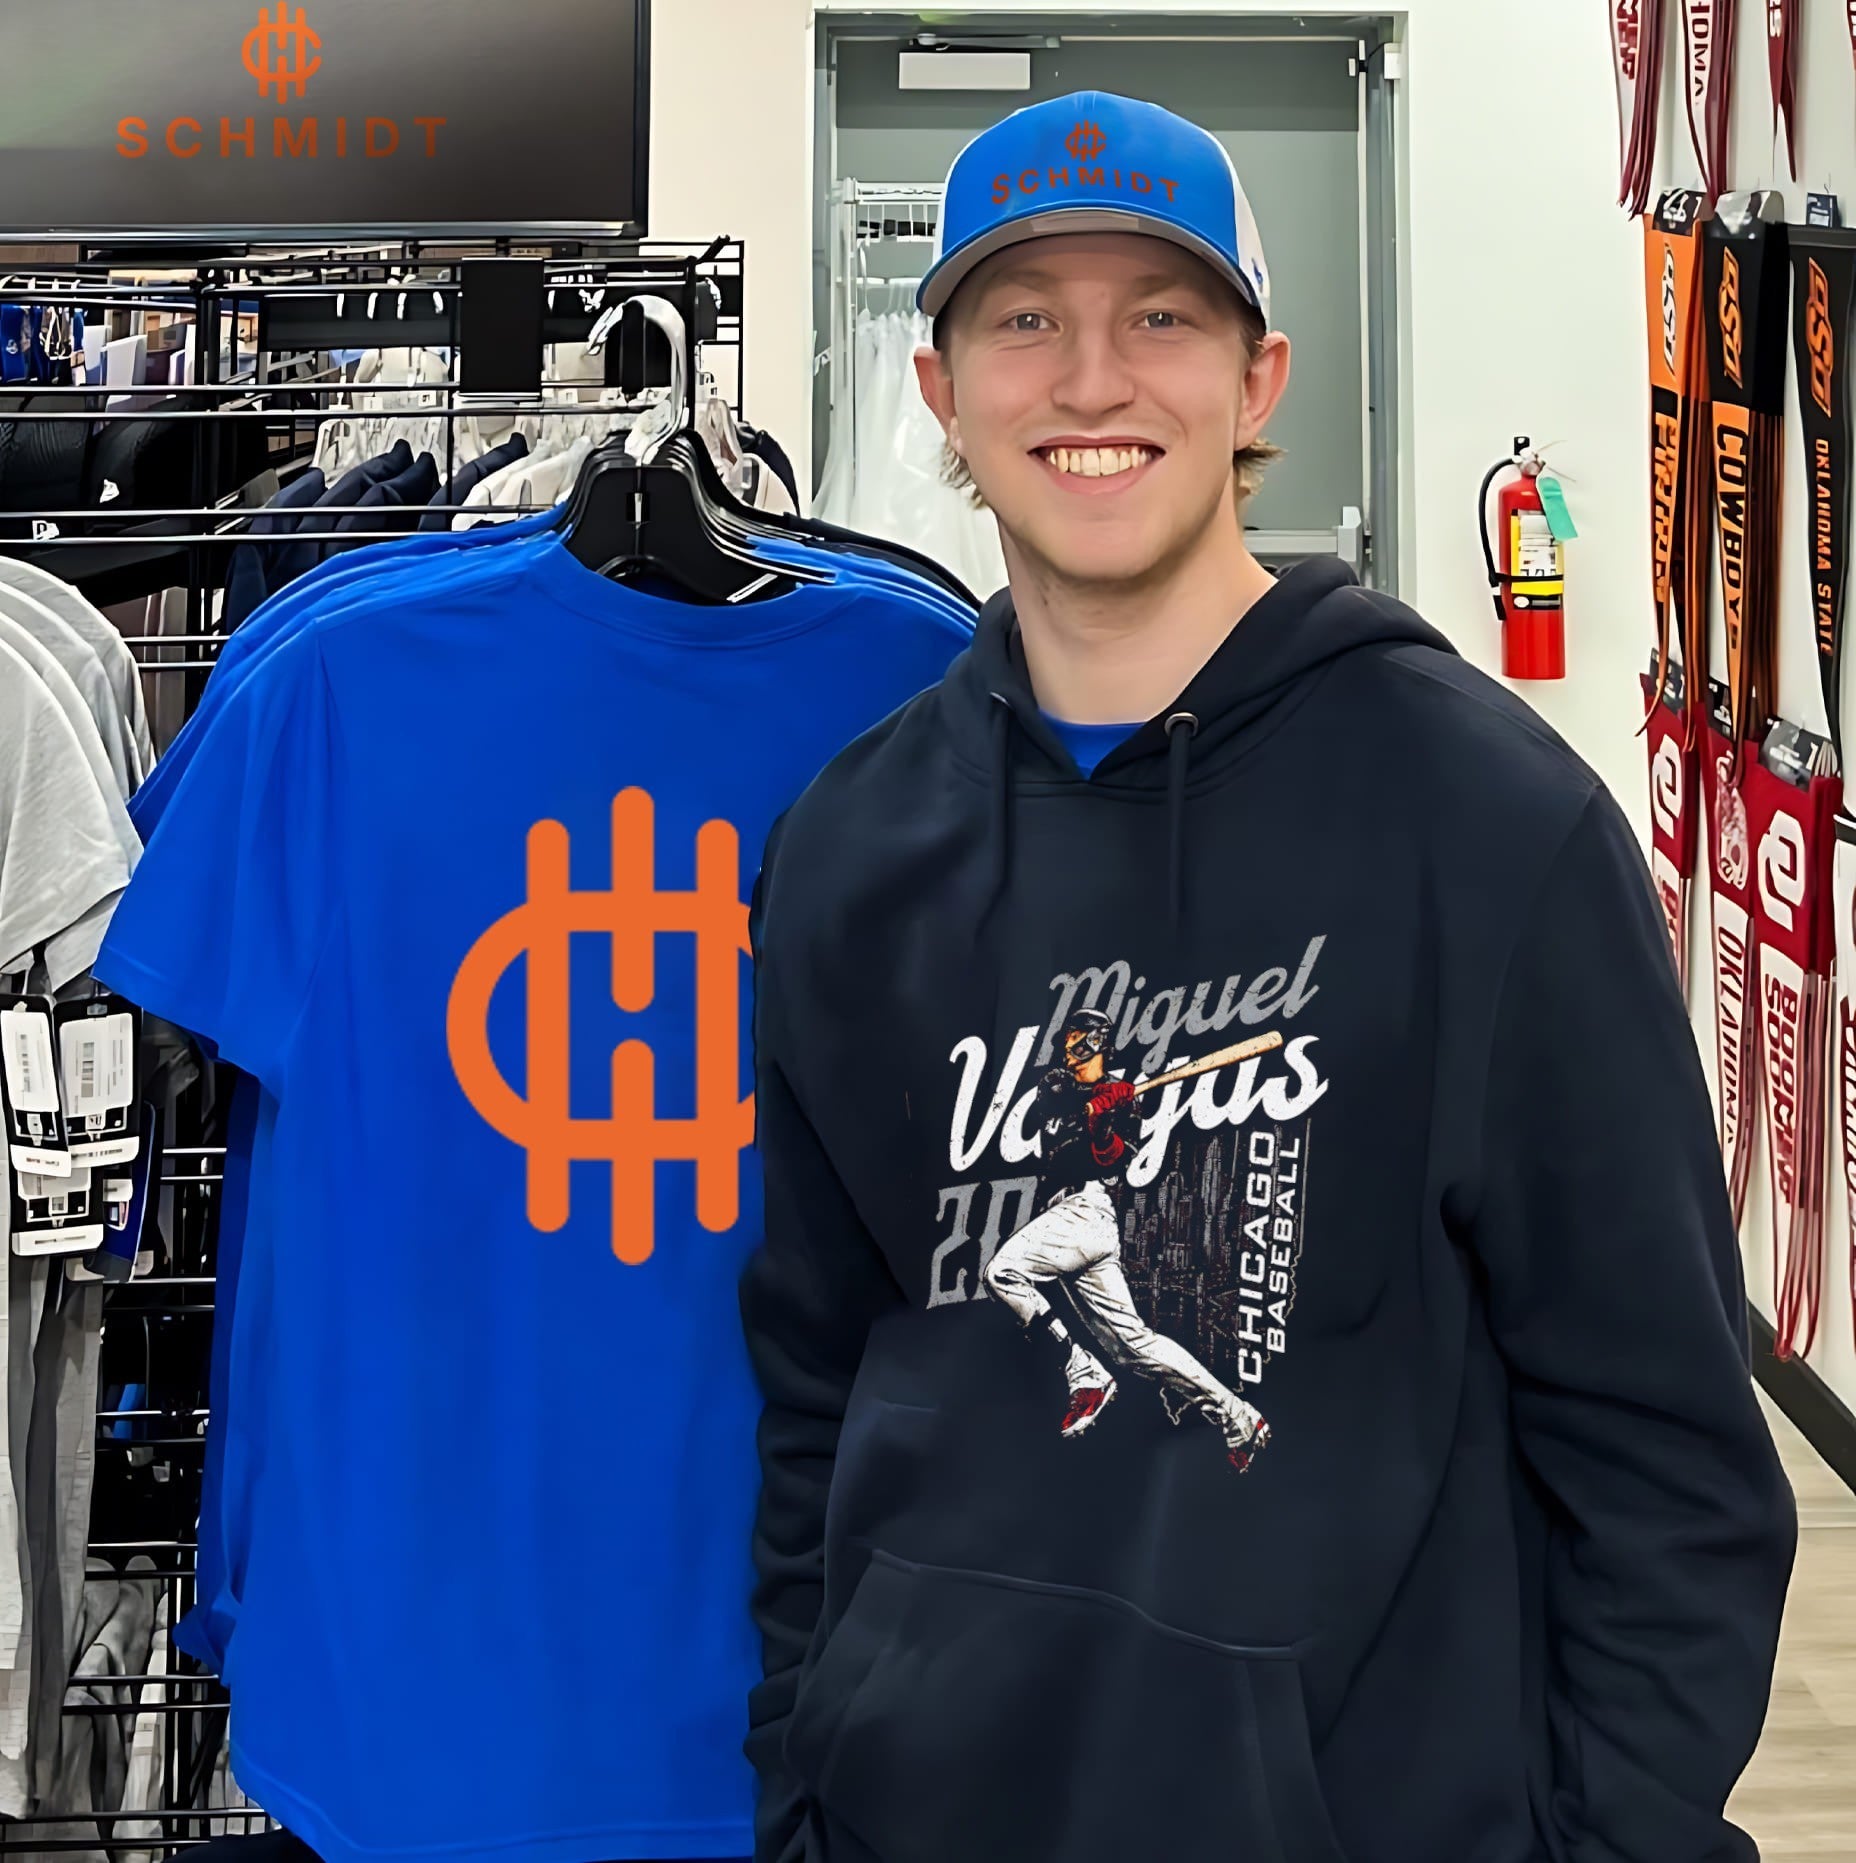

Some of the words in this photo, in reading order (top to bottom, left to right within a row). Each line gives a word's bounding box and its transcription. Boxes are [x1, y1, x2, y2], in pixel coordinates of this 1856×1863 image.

[116, 117, 447, 158] SCHMIDT
[992, 167, 1179, 204] SCHMIDT
[1034, 934, 1328, 1072] Miguel
[949, 1025, 1329, 1188] Vagas
[1238, 1131, 1275, 1384] CHICAGO
[1266, 1138, 1300, 1353] BASEBALL
